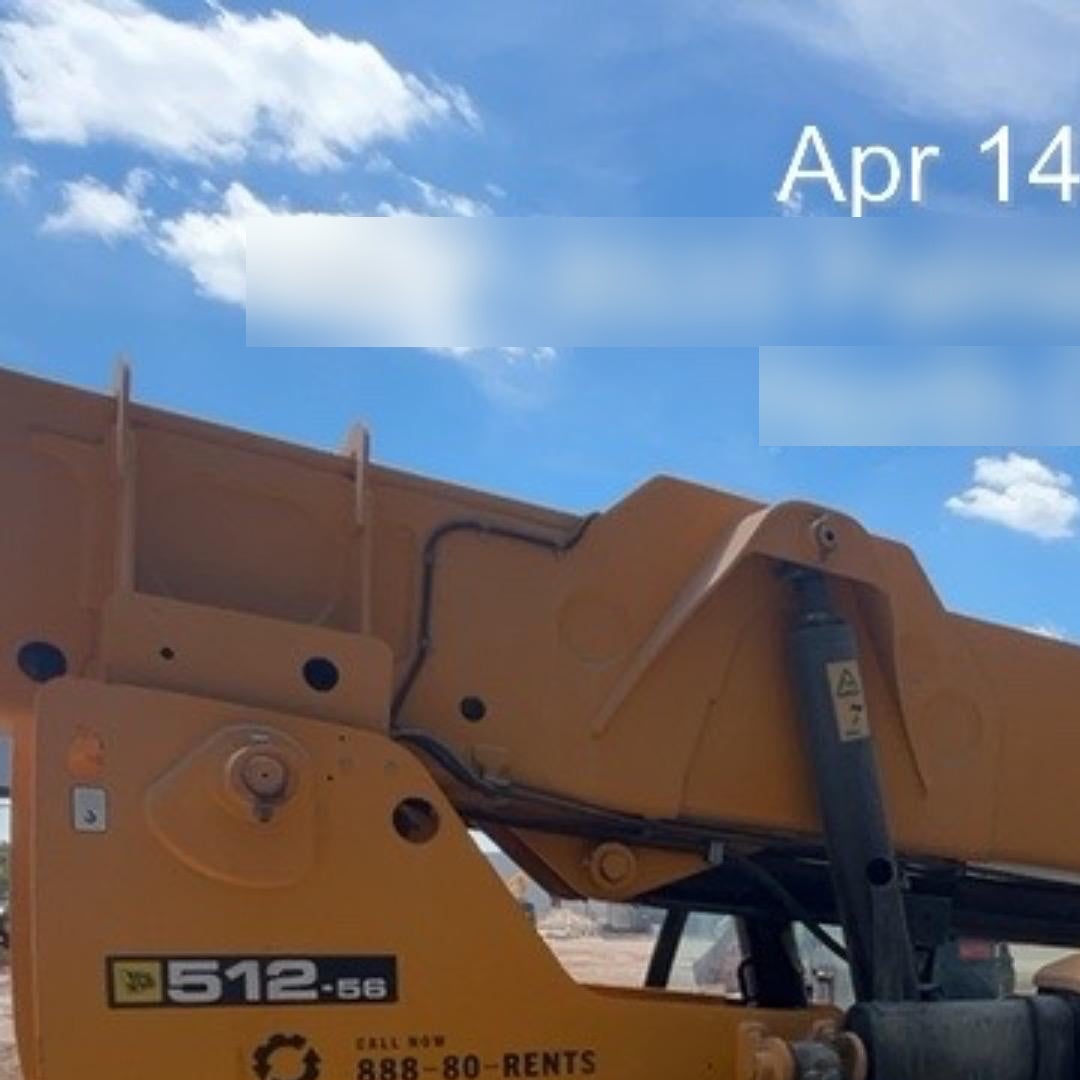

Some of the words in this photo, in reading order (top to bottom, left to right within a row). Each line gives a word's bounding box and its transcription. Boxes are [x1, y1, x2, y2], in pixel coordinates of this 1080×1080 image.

[167, 959, 388, 1003] 512-56
[356, 1035, 401, 1050] CALL
[408, 1034, 445, 1049] NOW
